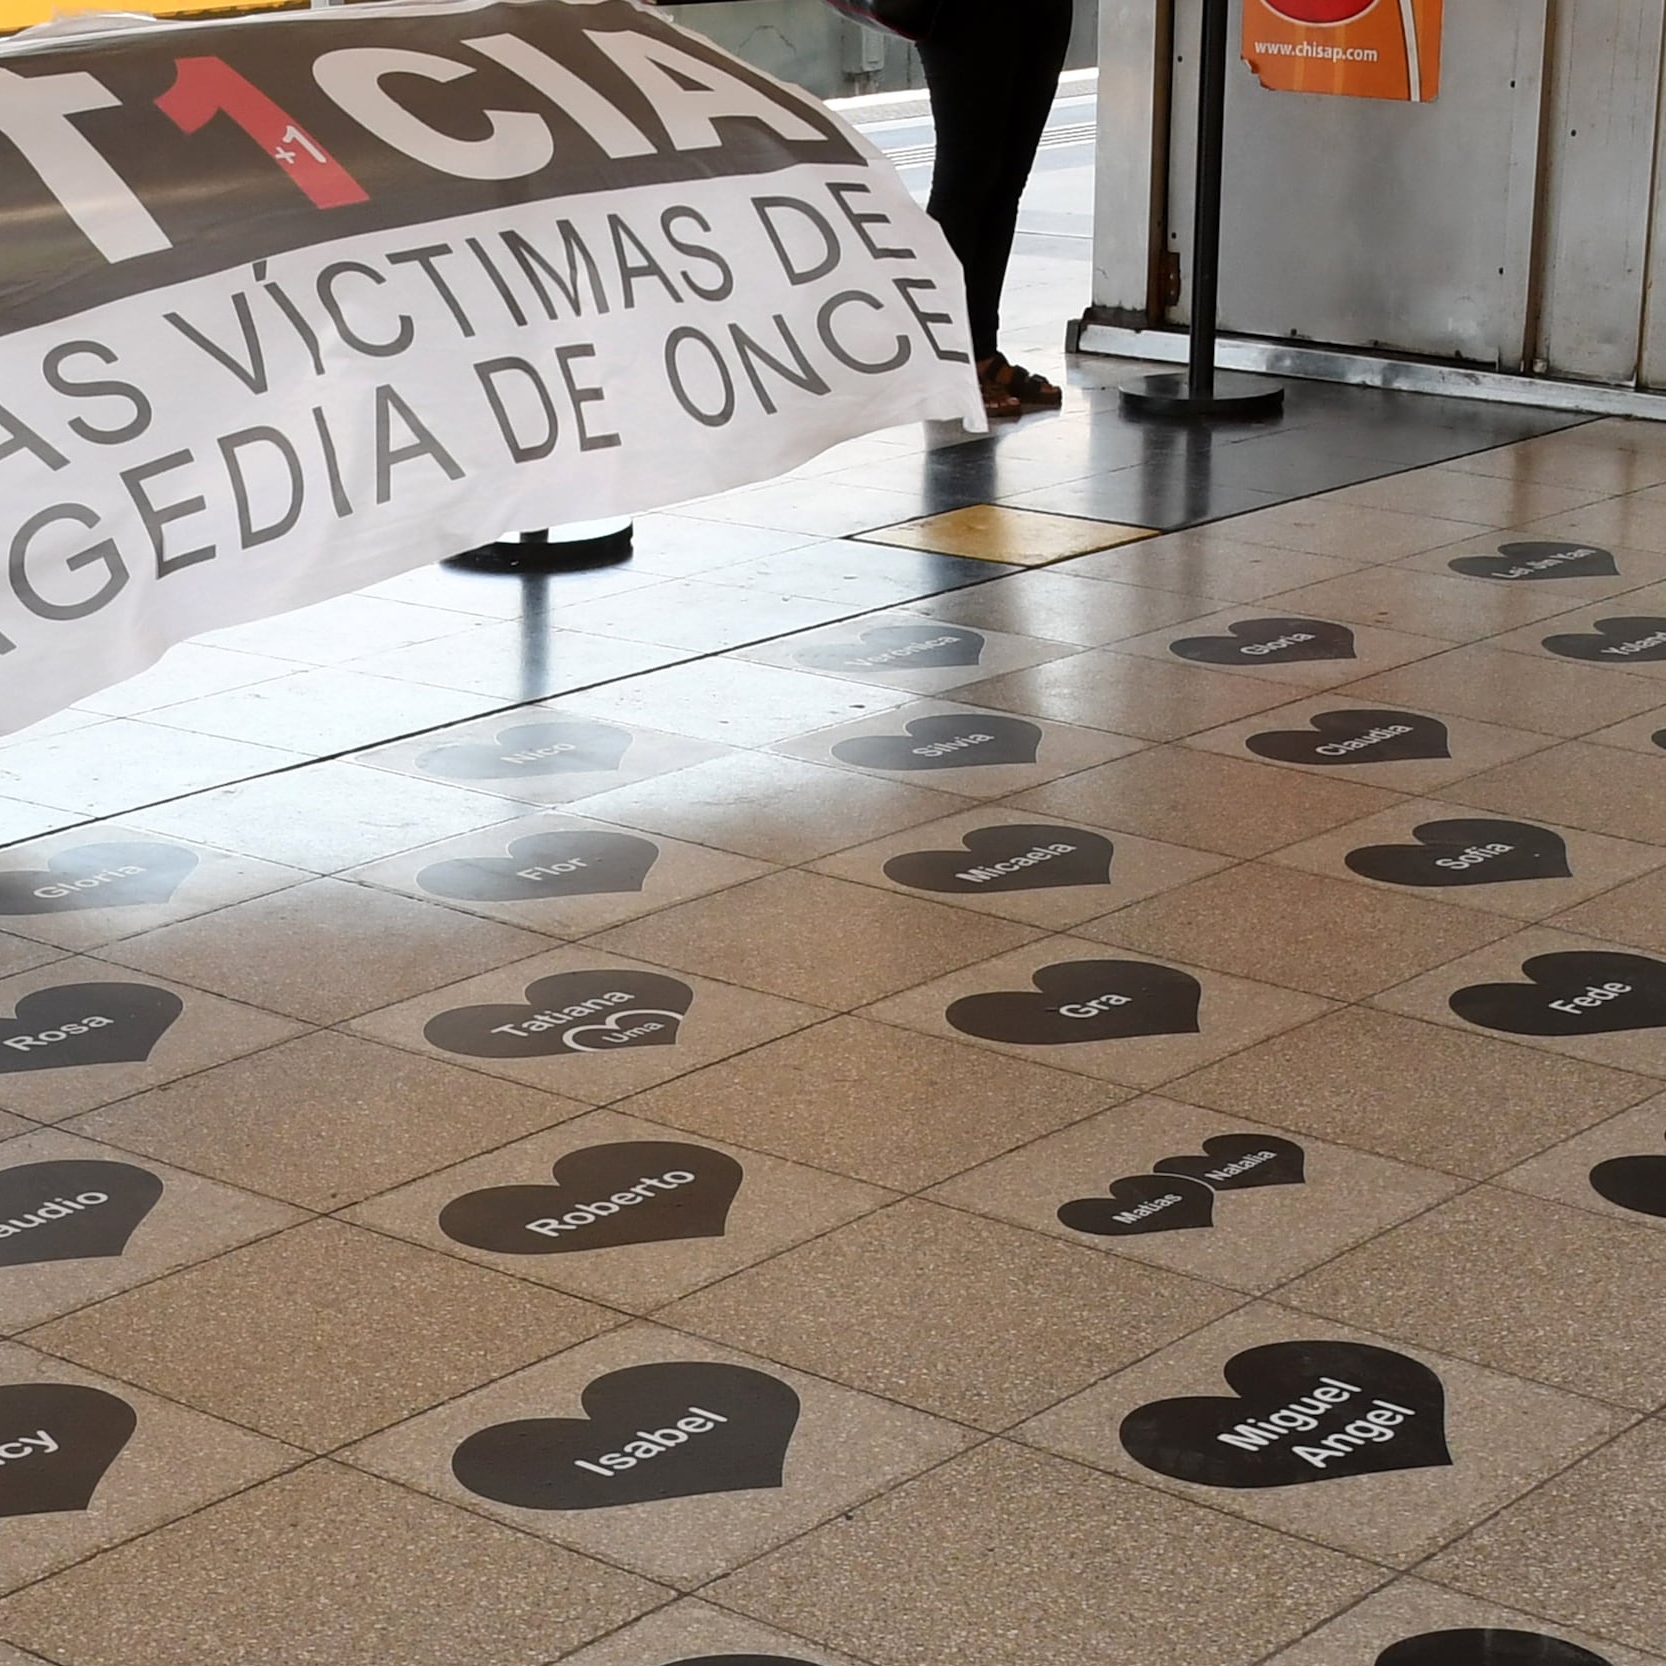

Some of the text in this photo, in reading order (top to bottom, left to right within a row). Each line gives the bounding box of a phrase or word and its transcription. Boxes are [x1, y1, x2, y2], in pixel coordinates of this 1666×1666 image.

[1253, 41, 1379, 63] www.chisap.com
[162, 205, 734, 395] VÍCTIMAS
[752, 181, 918, 286] DE
[473, 344, 621, 463] DE
[664, 277, 970, 428] ONCE
[1239, 632, 1316, 656] Gloria
[499, 741, 577, 765] Nico
[911, 731, 992, 759] Silvia
[1314, 724, 1415, 757] Claudia
[515, 855, 588, 882] Flor
[954, 842, 1078, 884] Micaela
[32, 864, 145, 900] Gloria
[489, 988, 636, 1040] Tatiana
[1058, 993, 1133, 1020] Gra
[1547, 981, 1633, 1015] Fede
[2, 1012, 115, 1052] Rosa
[607, 1019, 663, 1045] Uma
[1206, 1147, 1279, 1183] Natalia
[523, 1163, 696, 1240] Roberto
[1216, 1375, 1364, 1455] Miguel
[573, 1405, 729, 1478] Isabel
[1292, 1398, 1417, 1471] Angel
